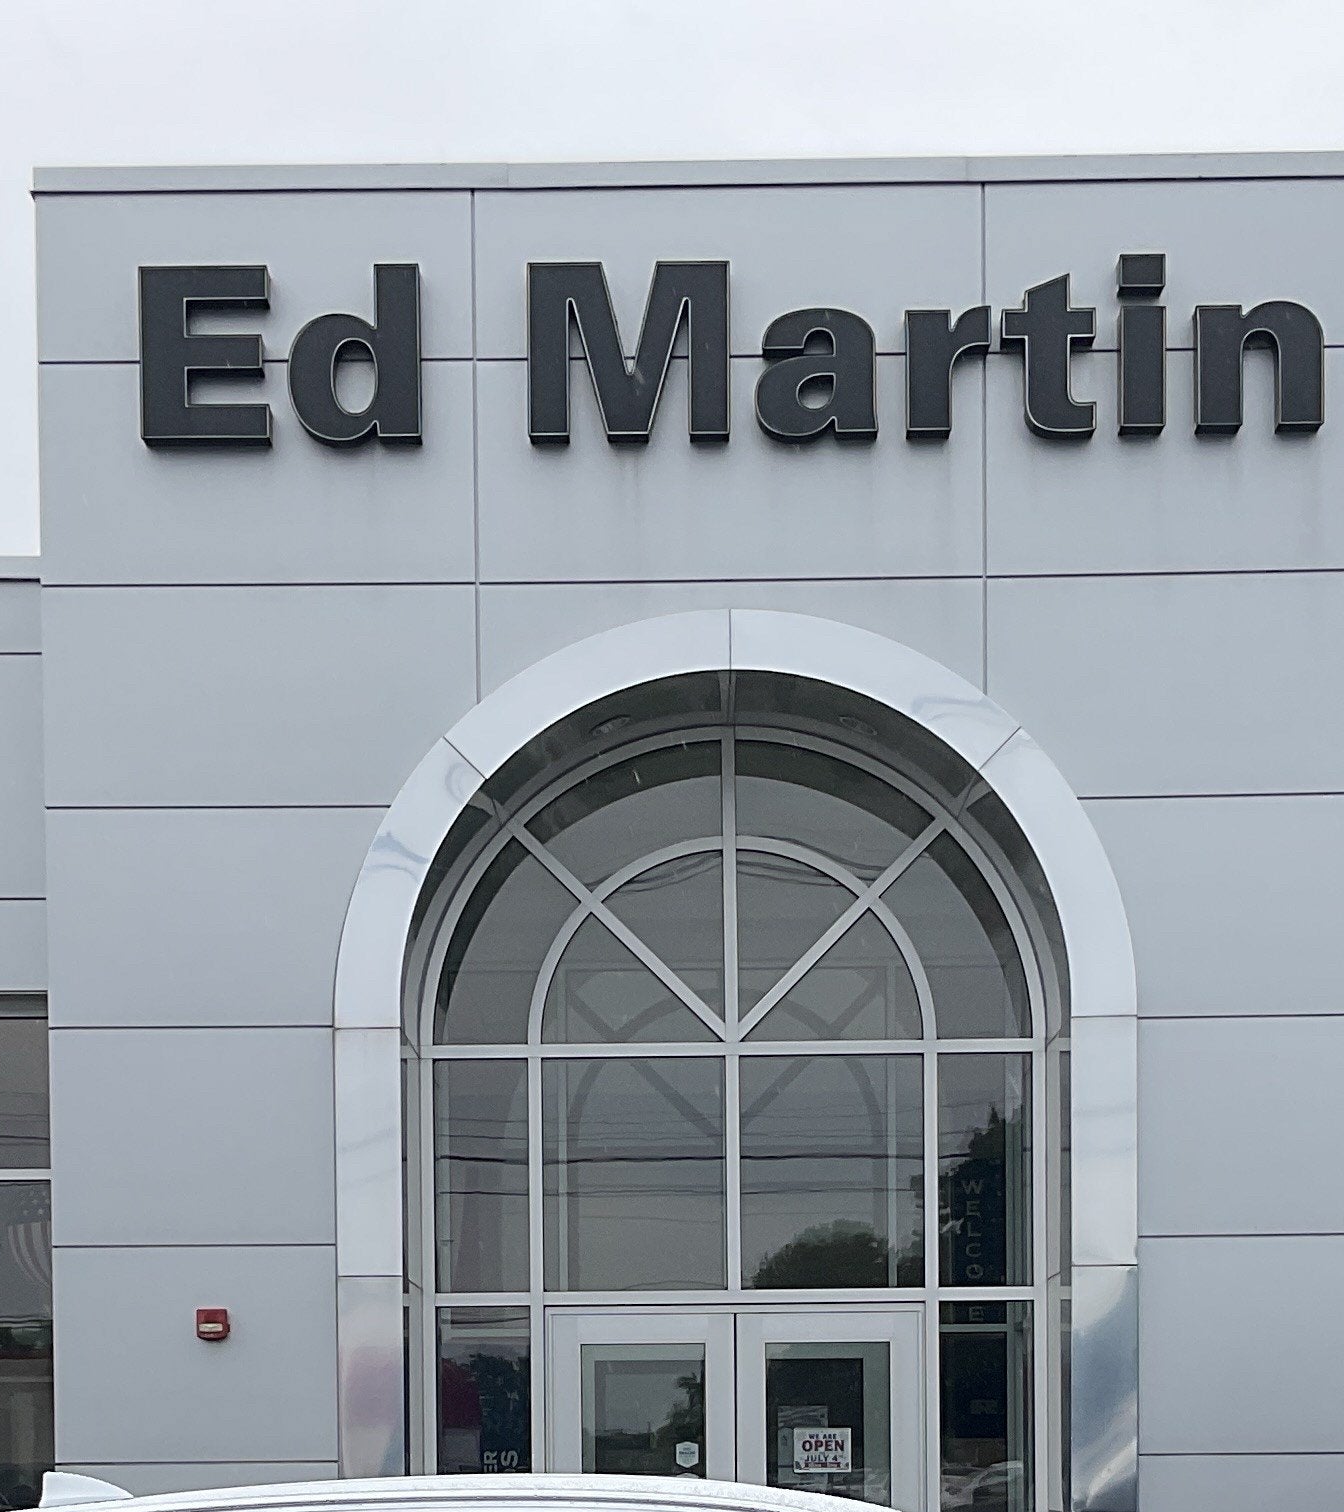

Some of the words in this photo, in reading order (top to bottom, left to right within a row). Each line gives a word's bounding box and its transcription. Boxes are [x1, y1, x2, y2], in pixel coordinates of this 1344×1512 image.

[139, 262, 423, 456] Ed
[529, 253, 1325, 452] Martin
[961, 1178, 986, 1322] WELCOE
[801, 1439, 845, 1452] OPEN
[805, 1454, 830, 1462] JULY
